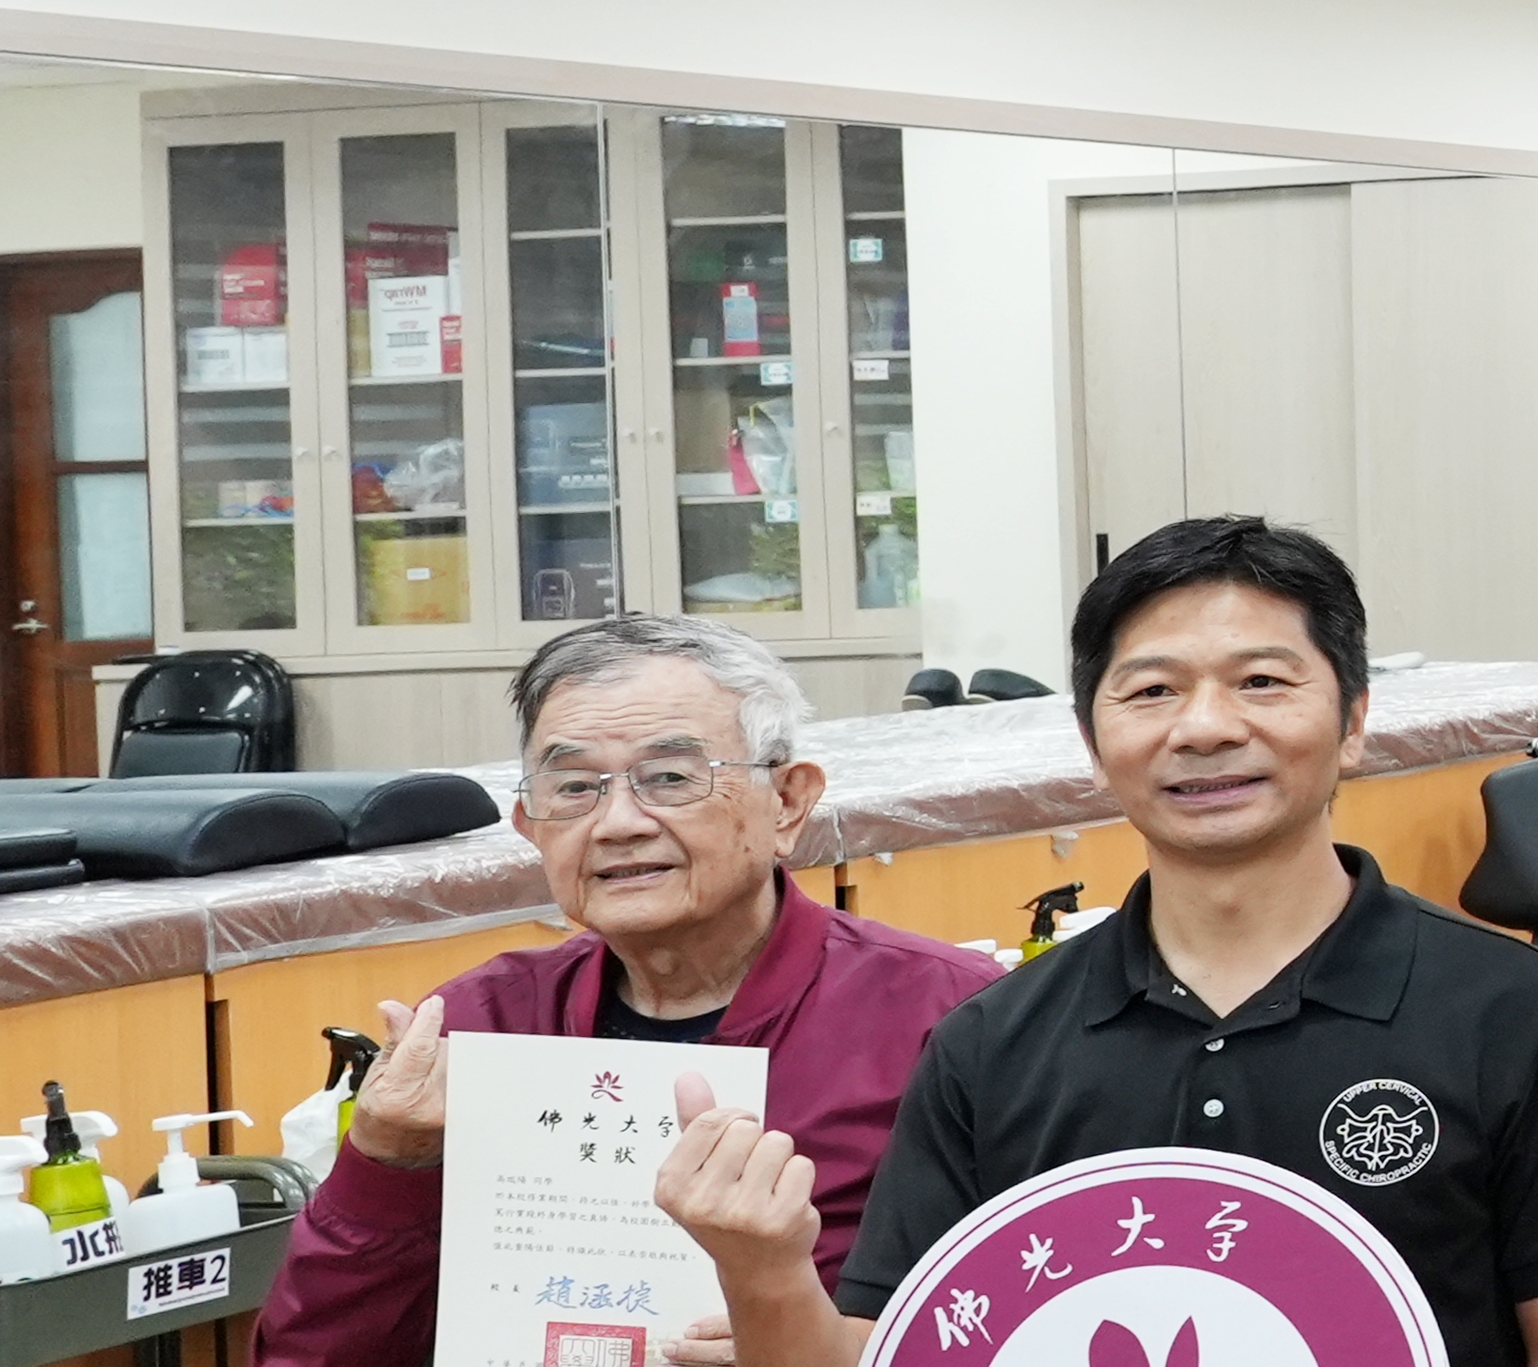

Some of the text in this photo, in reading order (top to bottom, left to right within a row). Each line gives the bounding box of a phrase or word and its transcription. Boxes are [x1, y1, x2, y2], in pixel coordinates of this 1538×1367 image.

[1342, 1080, 1424, 1106] UPPER CERVICAL
[579, 1142, 636, 1165] 獎狀
[1324, 1139, 1433, 1184] SPECIFIC CHIROPRACTIC
[142, 1254, 228, 1303] 推車2
